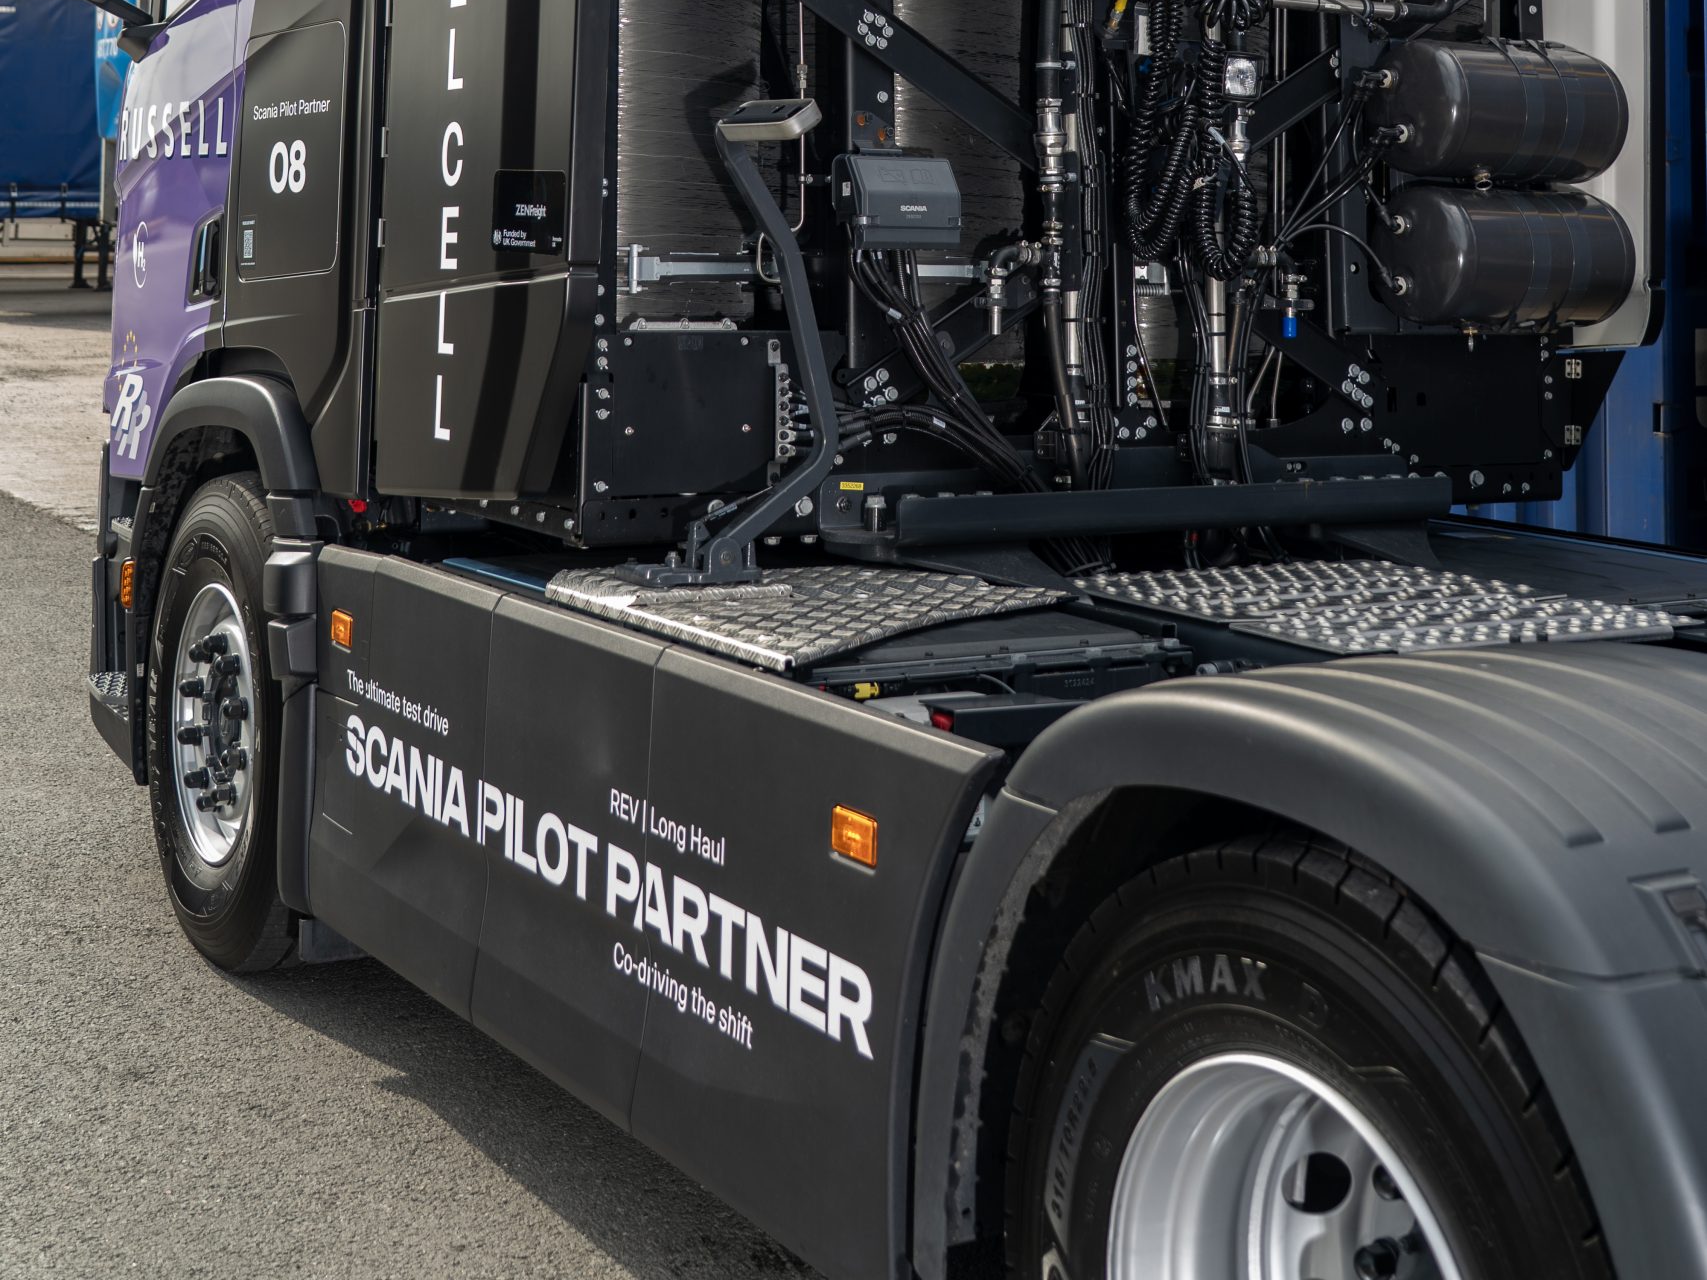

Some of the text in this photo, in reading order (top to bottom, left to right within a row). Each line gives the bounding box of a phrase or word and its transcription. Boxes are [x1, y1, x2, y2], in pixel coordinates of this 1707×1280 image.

[119, 97, 228, 161] RUSSELL
[253, 99, 331, 120] Scania Pilot Partner
[269, 139, 306, 194] 08
[502, 238, 536, 248] UK Government
[503, 229, 527, 240] Funded by
[434, 121, 464, 441] CELL
[346, 669, 449, 736] The ultimate test drive
[609, 787, 640, 825] REV
[650, 805, 687, 854] Long
[690, 824, 725, 867] Haul
[345, 714, 875, 1061] SCANIA PILOT PARTNER
[613, 941, 754, 1050] Co-driving the shift
[1144, 954, 1268, 1012] KMAX
